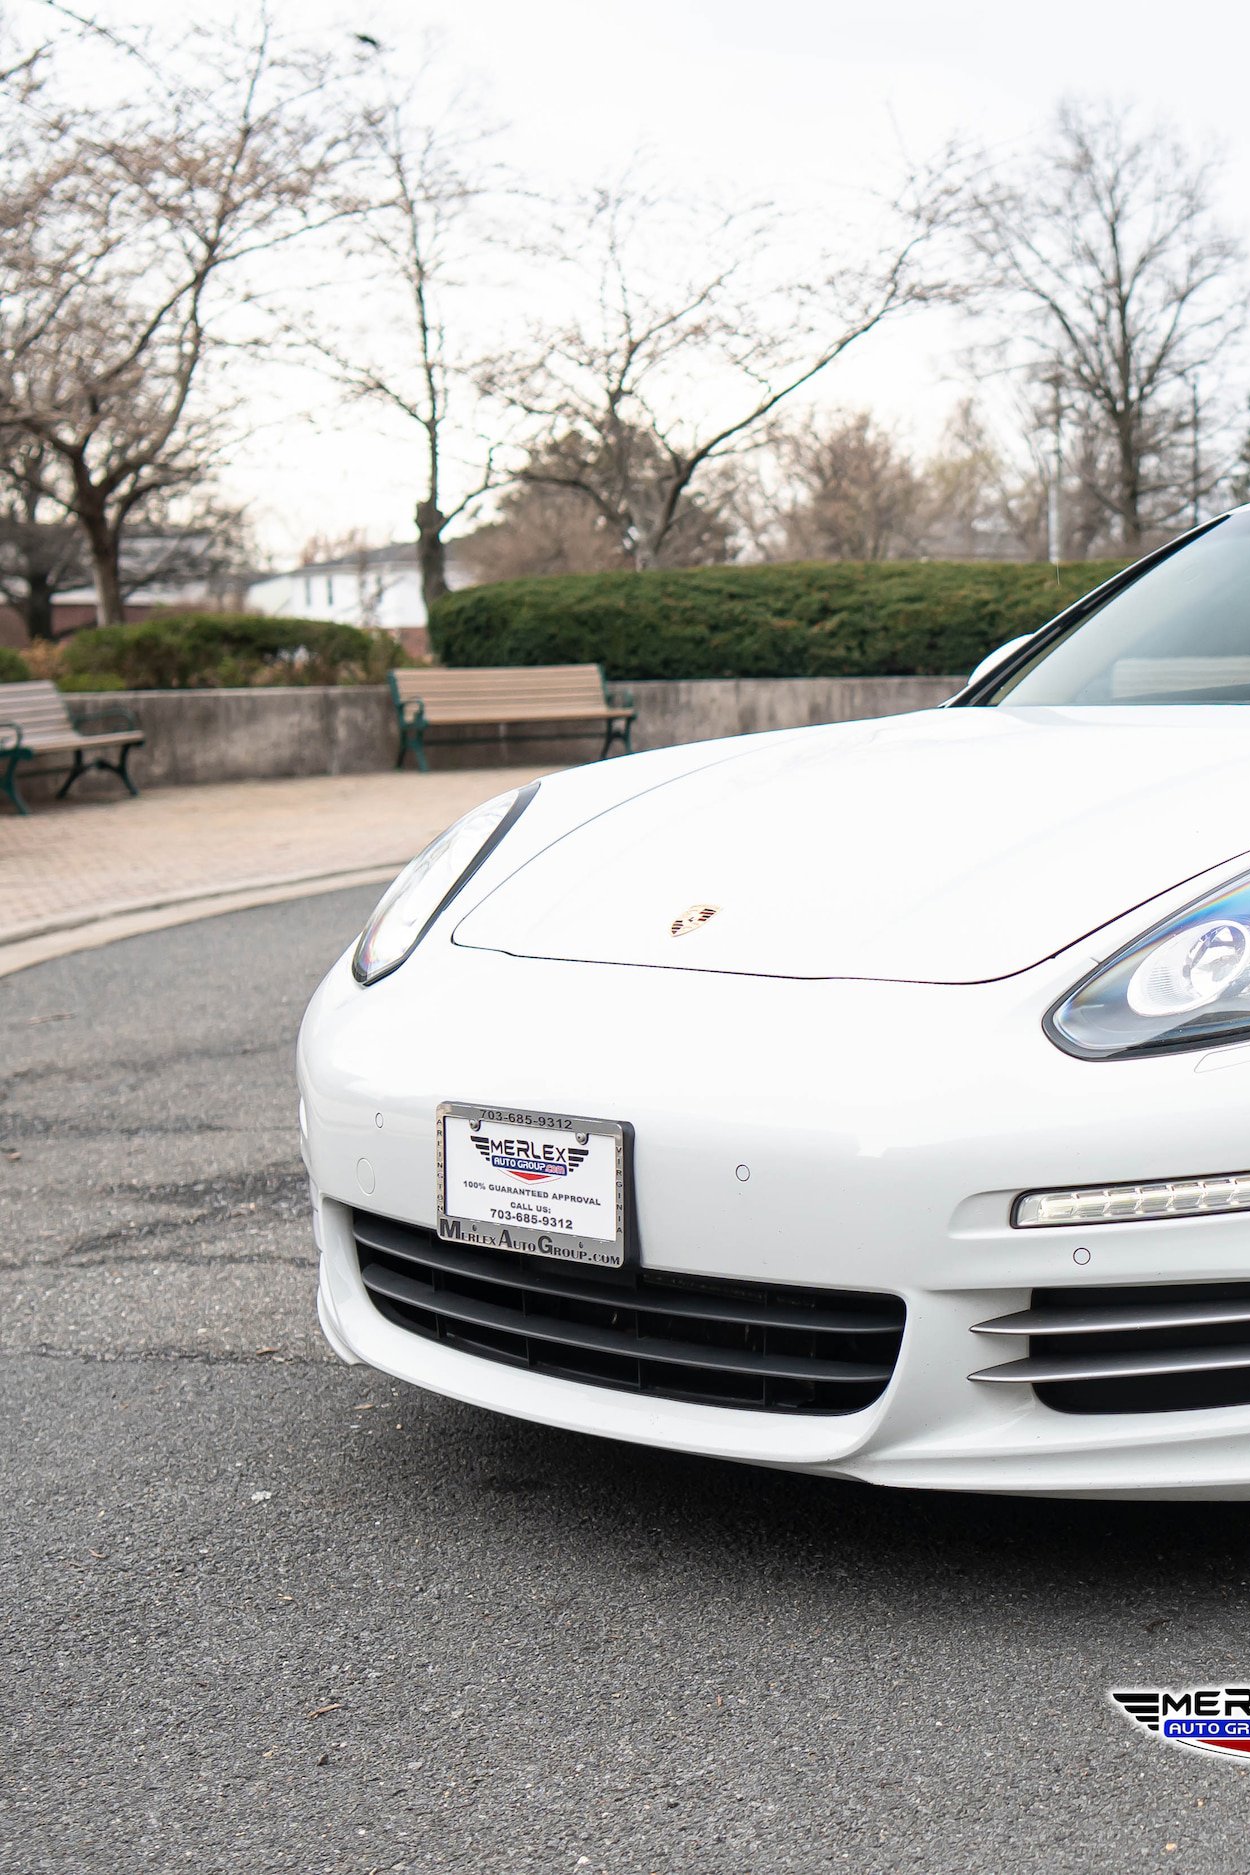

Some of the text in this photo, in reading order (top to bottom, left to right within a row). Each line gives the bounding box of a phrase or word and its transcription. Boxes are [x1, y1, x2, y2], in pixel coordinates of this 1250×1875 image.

[480, 1109, 573, 1130] 703-685-9312
[490, 1139, 566, 1163] MERLEX
[436, 1119, 444, 1213] ARLINGTON
[493, 1157, 516, 1168] AUTO
[463, 1180, 601, 1206] 100% GUARANTEED APPROVAL
[615, 1147, 623, 1234] VIRGINIA
[490, 1209, 573, 1229] 703-685-9312
[510, 1202, 551, 1214] CALL US:
